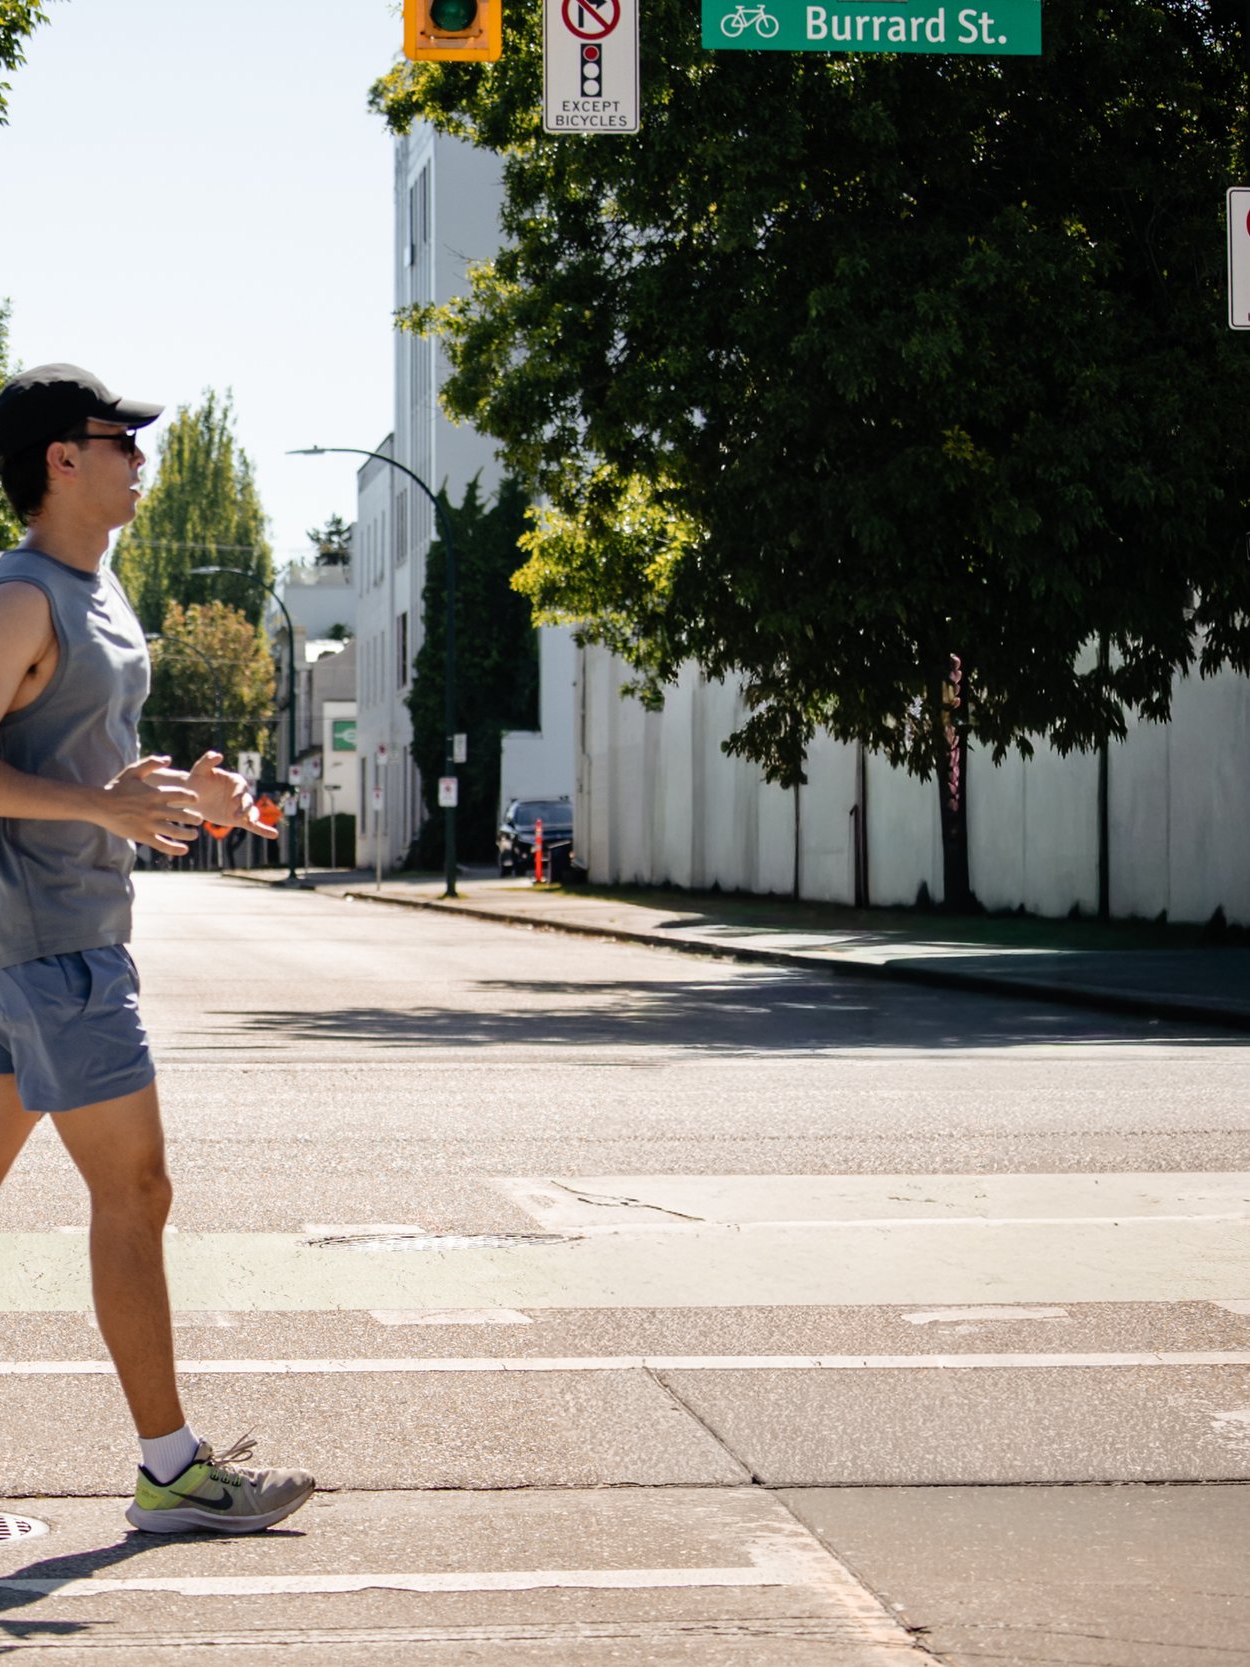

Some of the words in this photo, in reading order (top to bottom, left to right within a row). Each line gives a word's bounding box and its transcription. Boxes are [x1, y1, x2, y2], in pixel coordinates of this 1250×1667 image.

[806, 6, 946, 43] Burrard
[957, 9, 1007, 44] St.
[562, 101, 620, 112] EXCEPT
[555, 115, 627, 127] BICYCLES
